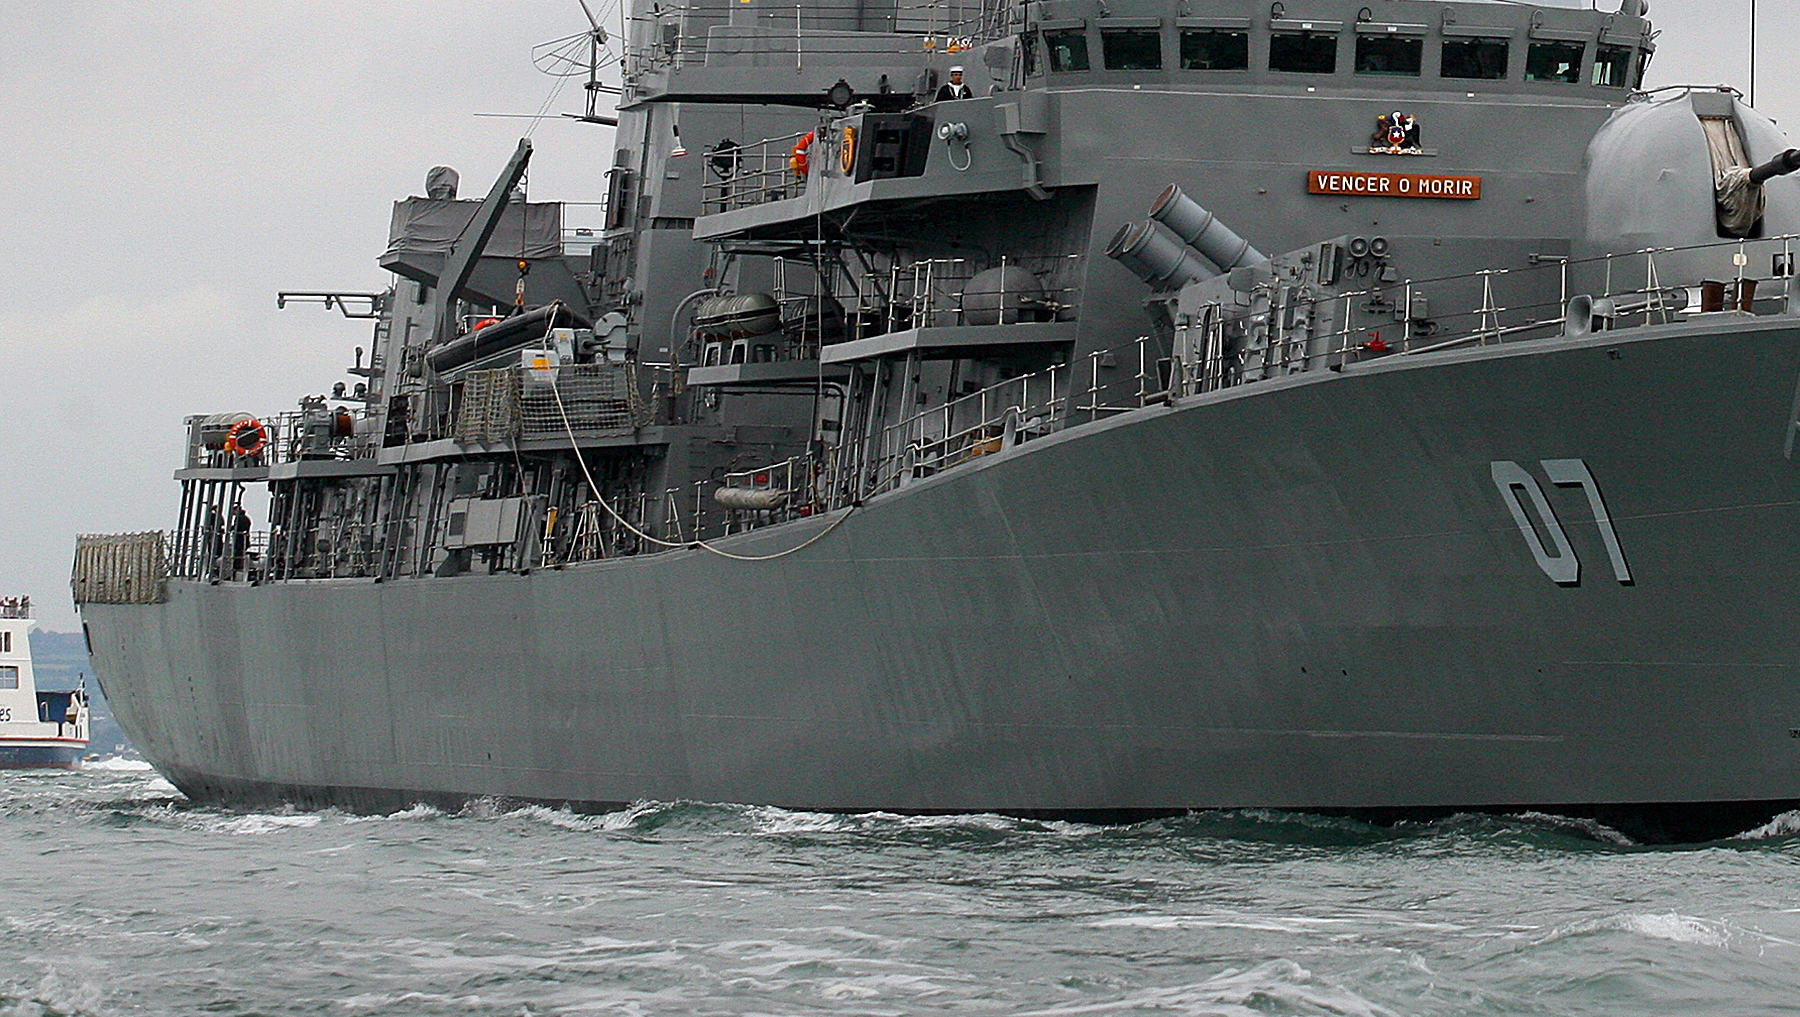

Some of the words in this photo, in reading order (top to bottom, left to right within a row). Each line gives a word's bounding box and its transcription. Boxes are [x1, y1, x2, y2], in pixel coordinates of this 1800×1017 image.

[1317, 174, 1390, 192] VENCER
[1399, 177, 1410, 193] O
[1418, 179, 1473, 195] MORIR
[1490, 458, 1636, 588] 07
